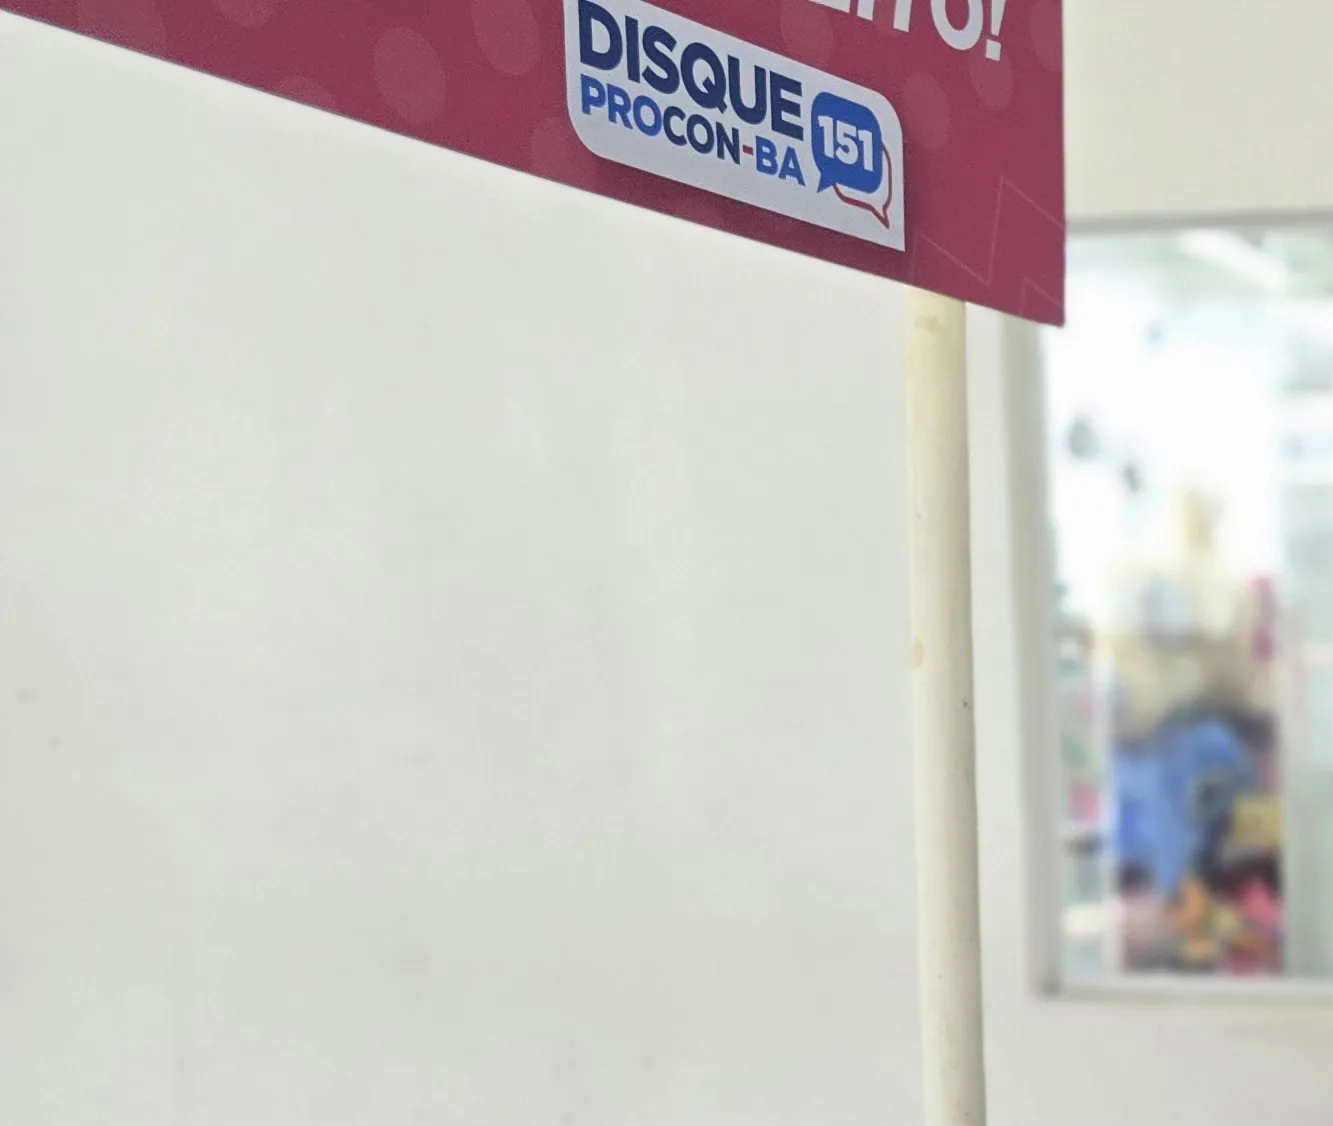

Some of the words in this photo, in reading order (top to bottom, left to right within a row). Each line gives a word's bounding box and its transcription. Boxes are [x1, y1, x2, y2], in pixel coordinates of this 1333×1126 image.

[577, 0, 804, 141] DISQUE
[580, 73, 806, 187] PROCON-BA
[817, 115, 875, 172] 151
